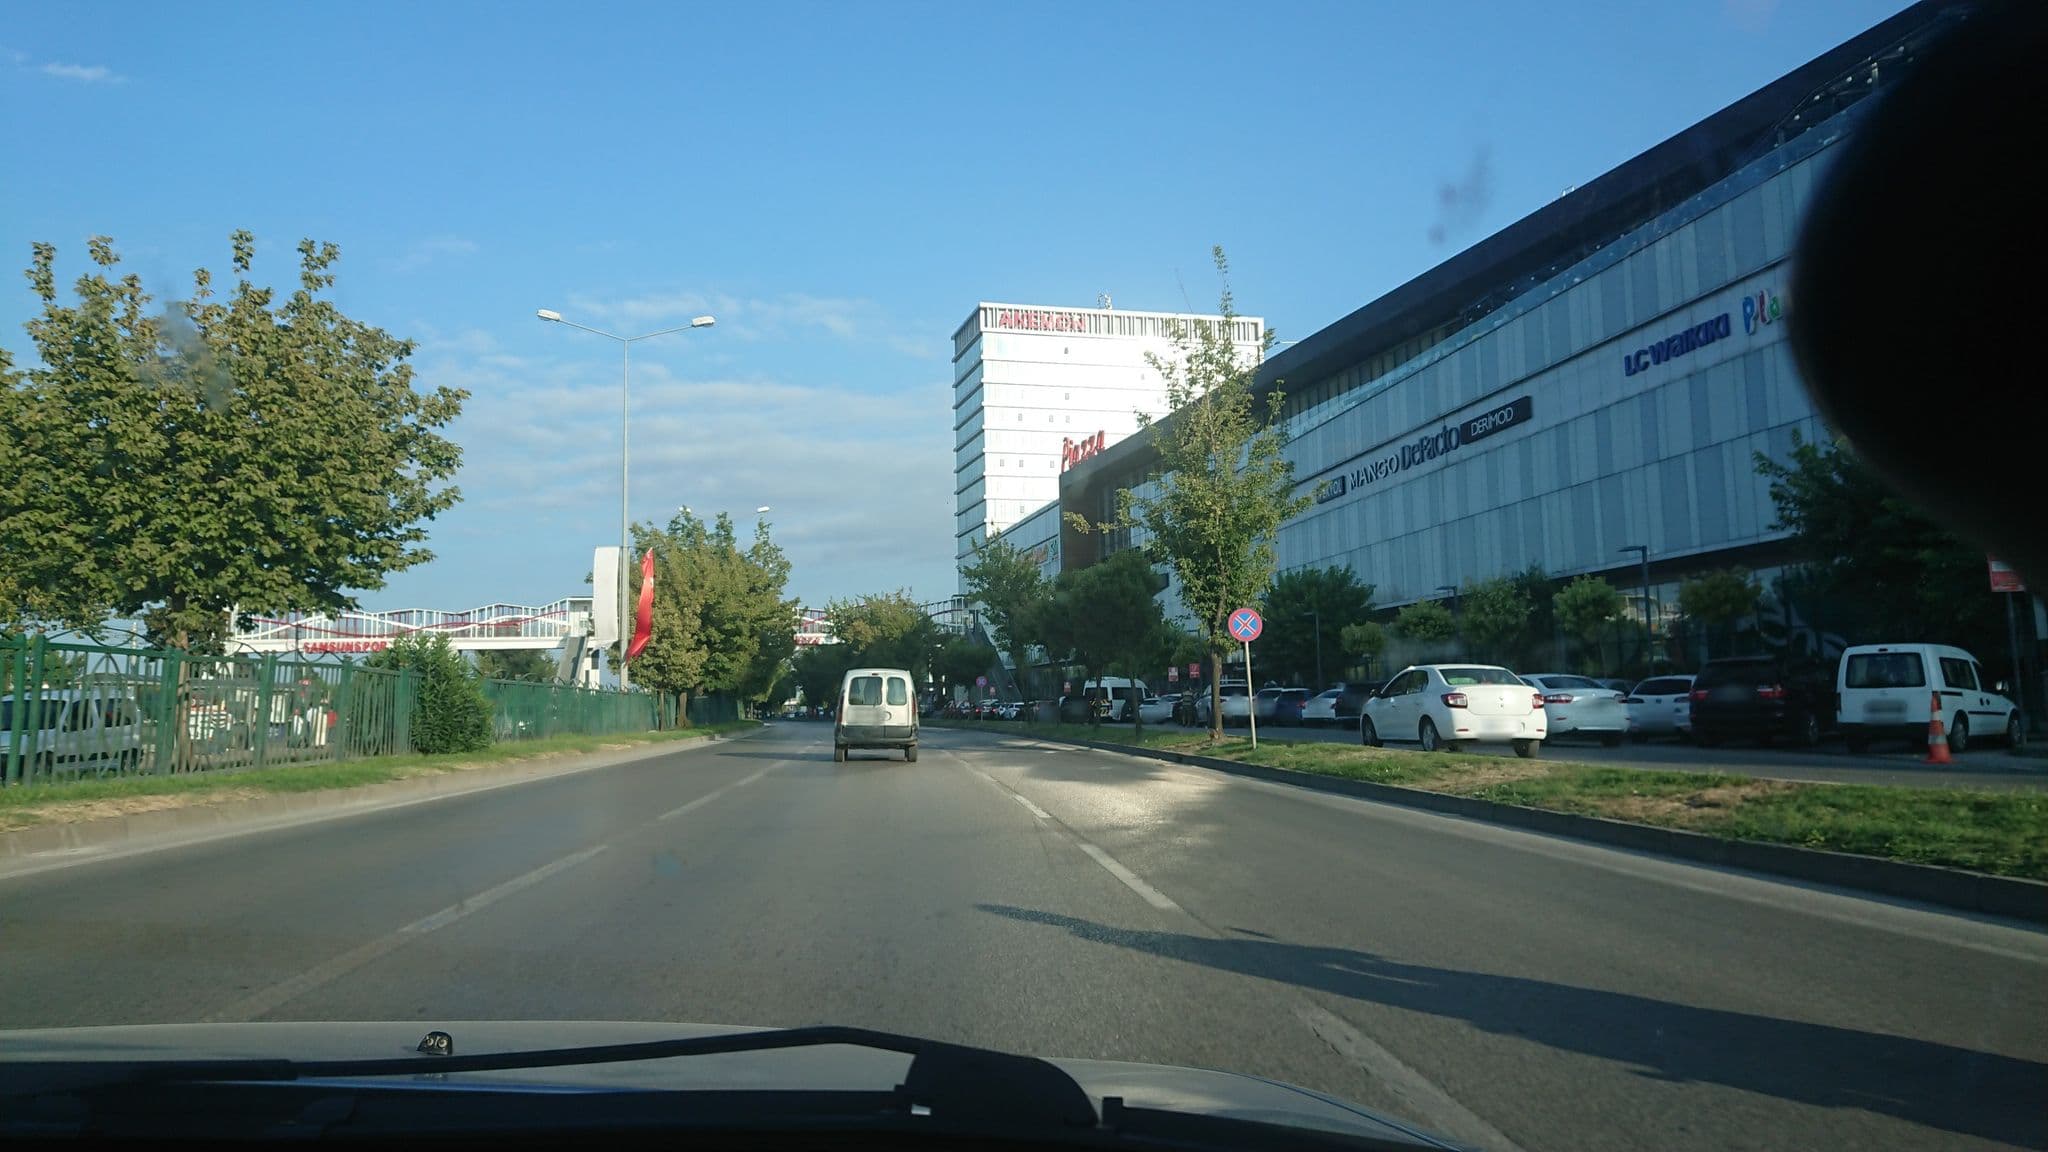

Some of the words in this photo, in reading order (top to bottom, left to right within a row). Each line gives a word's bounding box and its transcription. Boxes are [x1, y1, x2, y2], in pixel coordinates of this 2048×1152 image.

[999, 311, 1086, 332] ANEMON
[1624, 349, 1649, 377] LC
[1349, 454, 1399, 490] MANGO
